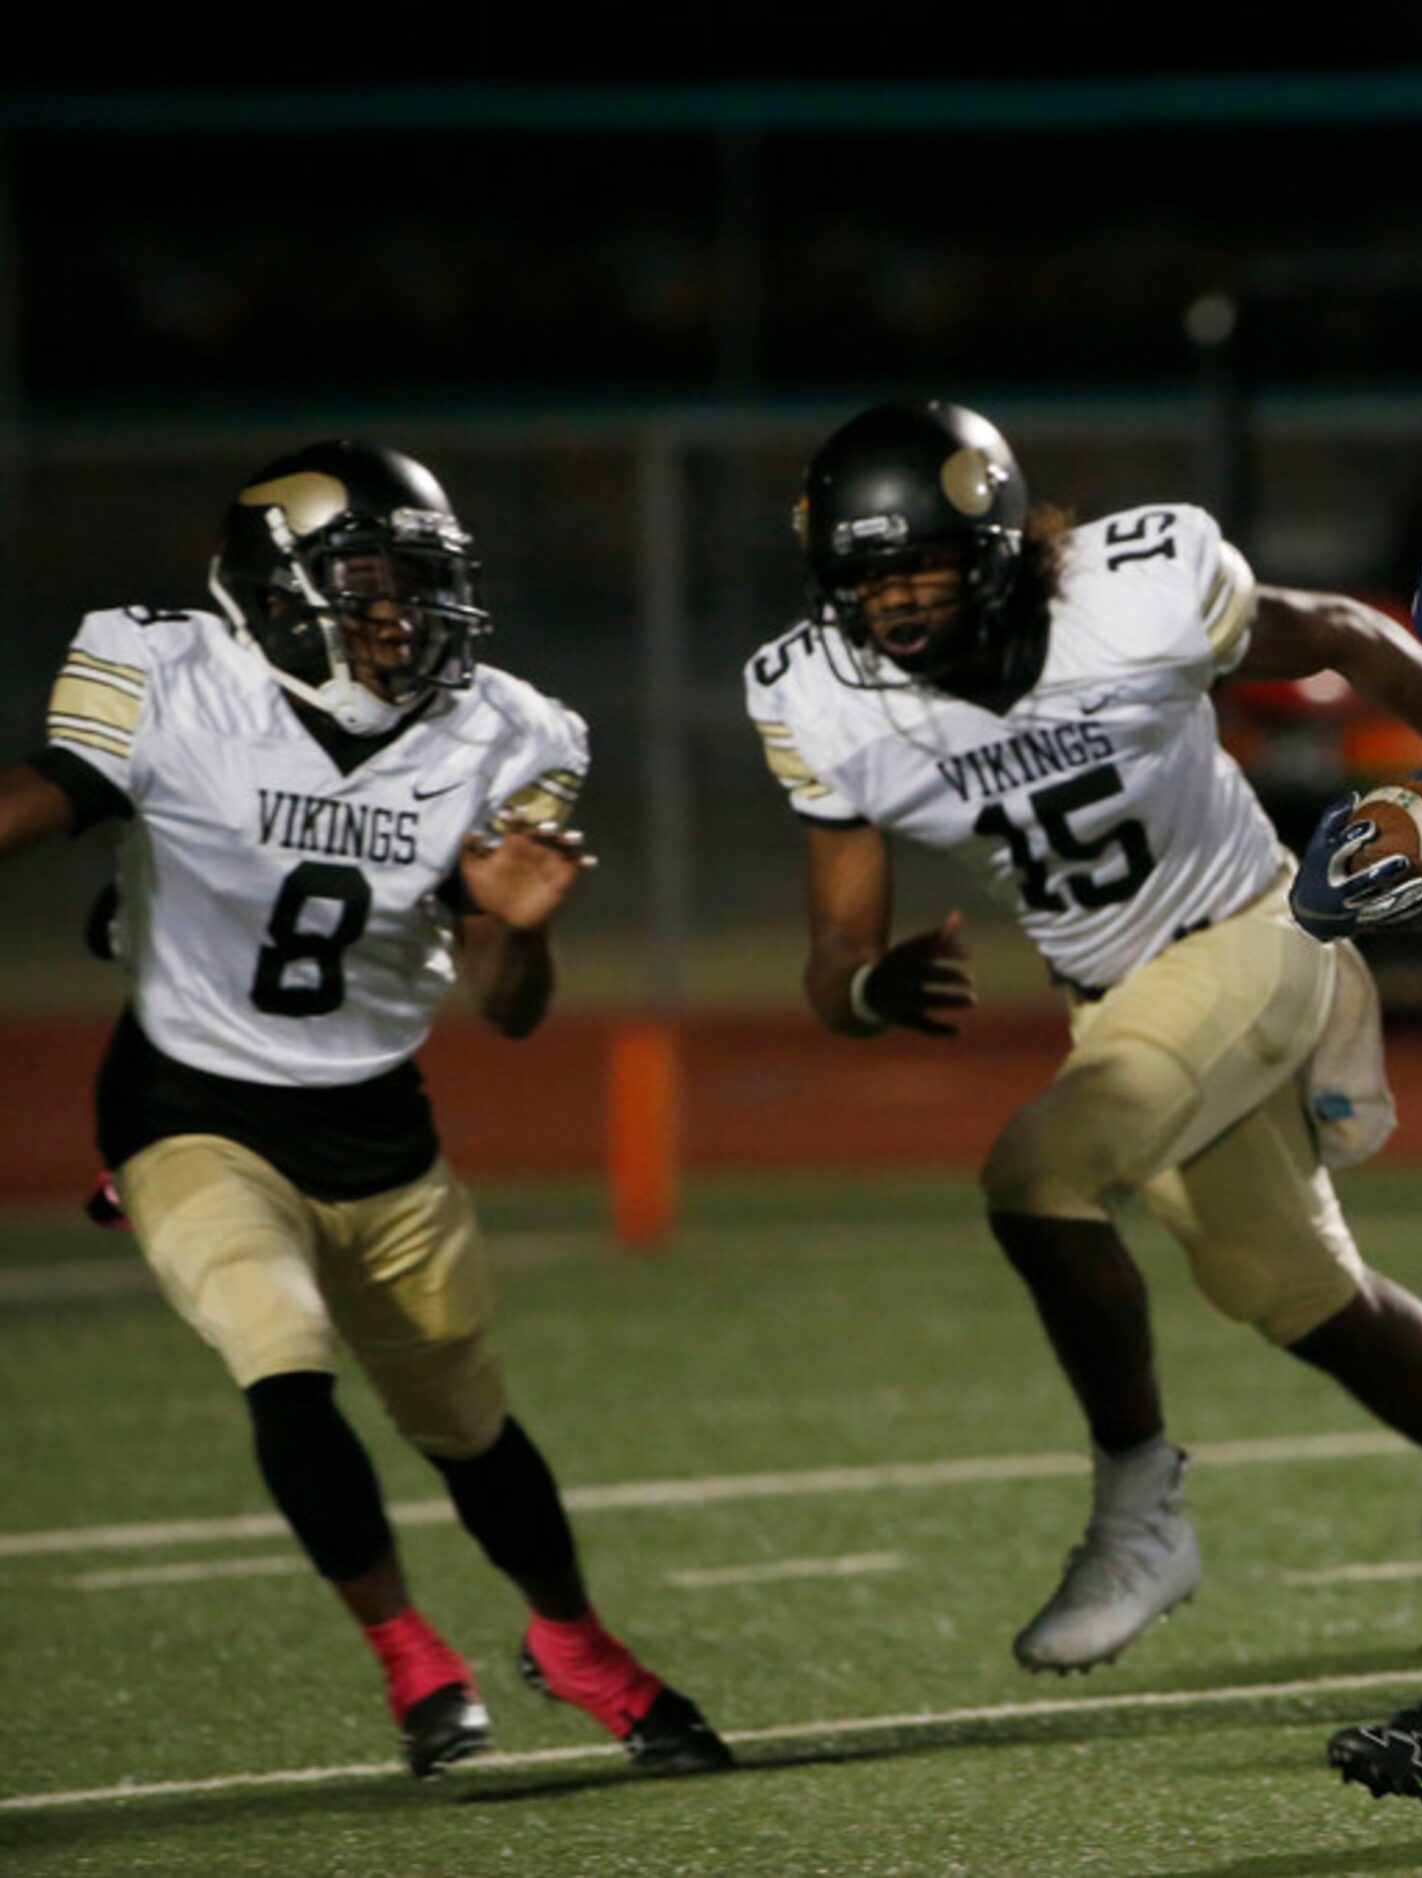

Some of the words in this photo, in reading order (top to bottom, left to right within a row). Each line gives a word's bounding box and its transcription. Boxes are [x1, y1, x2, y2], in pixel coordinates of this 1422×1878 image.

[1105, 509, 1178, 573] 15
[937, 720, 1115, 802] VIKINGS
[257, 789, 420, 866] VIKINGS
[973, 764, 1158, 913] 15
[250, 860, 373, 1018] 8
